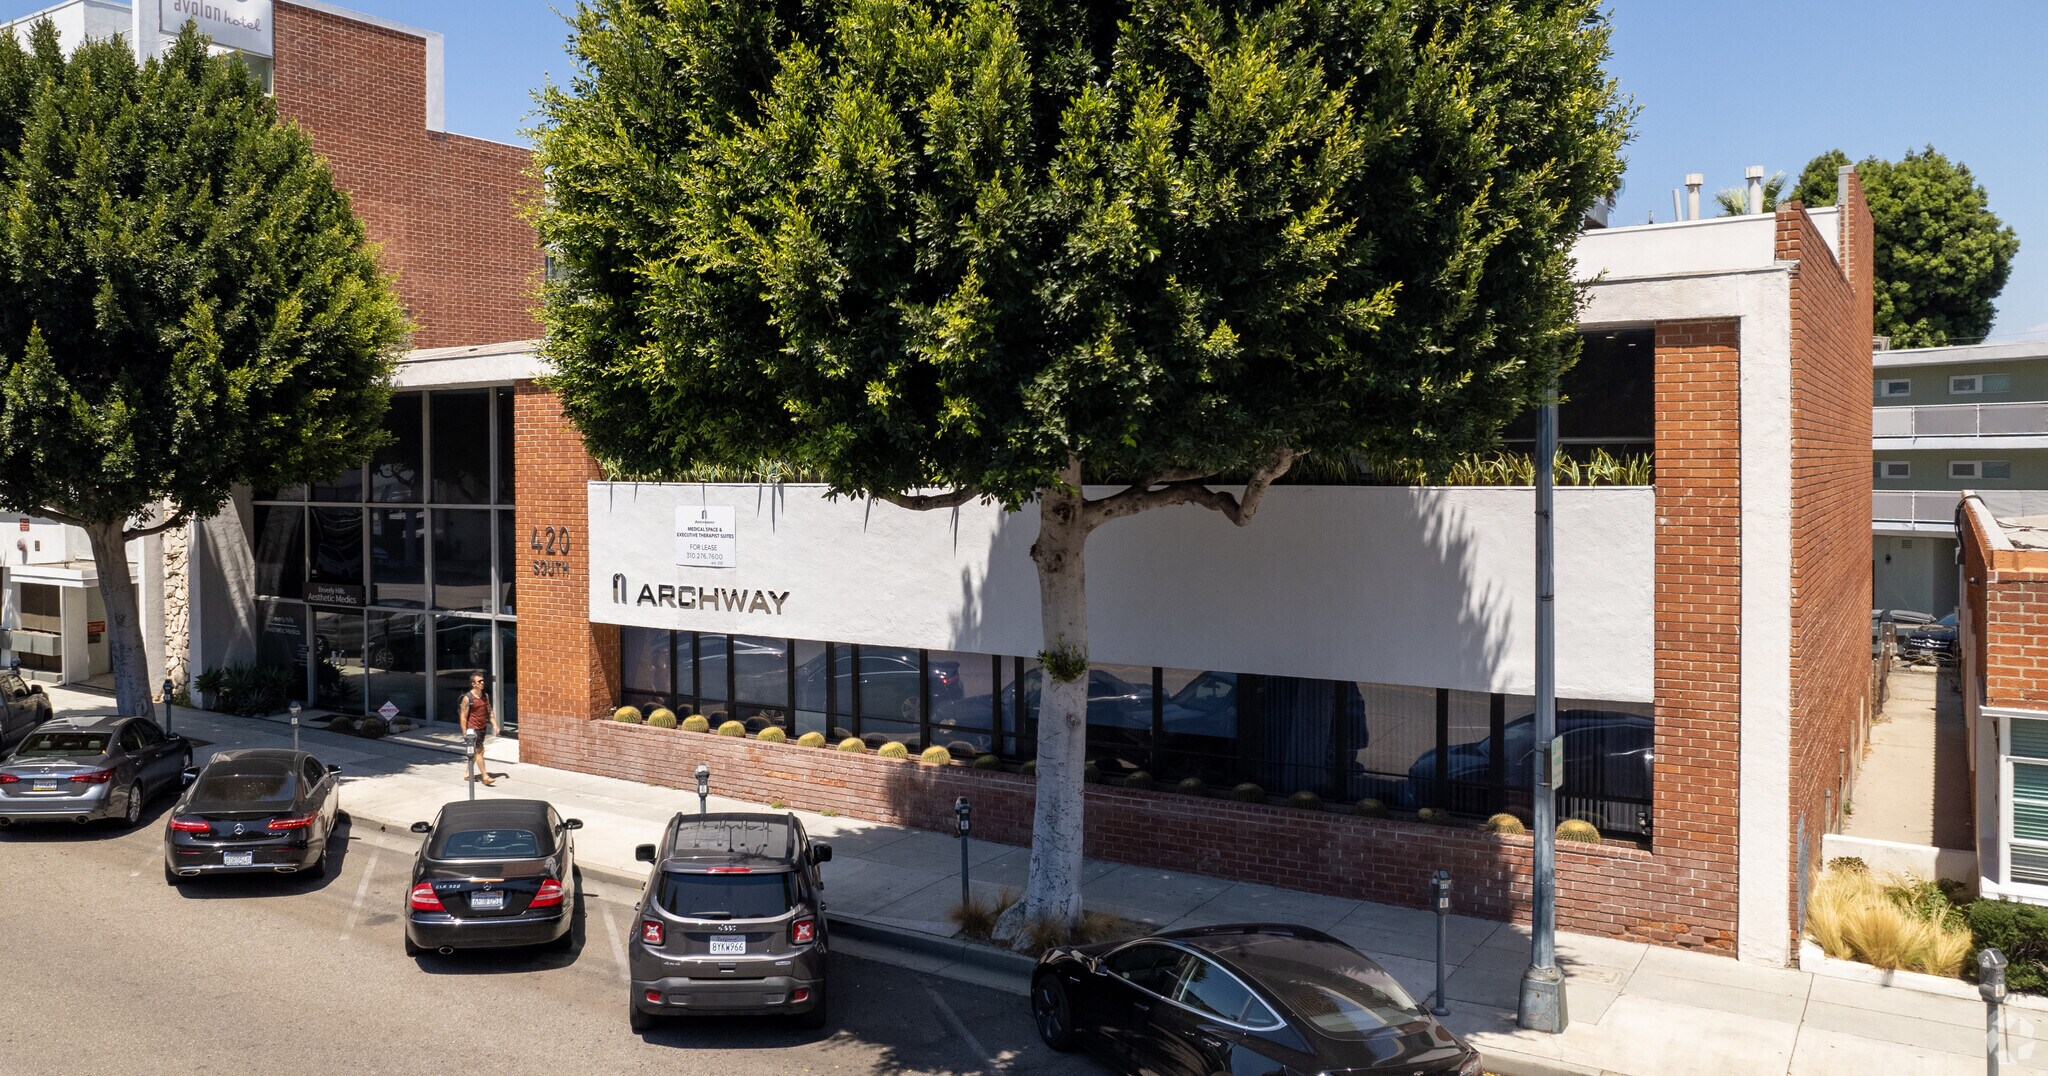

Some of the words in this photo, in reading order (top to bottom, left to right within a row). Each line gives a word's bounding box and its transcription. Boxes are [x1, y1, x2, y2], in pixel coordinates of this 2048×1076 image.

[224, 10, 262, 31] hotel
[531, 526, 570, 556] 420
[686, 552, 723, 560] 310.276.7600
[533, 560, 570, 578] SOUTH
[307, 592, 335, 602] Aesthetic
[336, 594, 357, 604] Medics
[318, 586, 335, 595] Beverly
[636, 583, 790, 615] ARCHWAY
[712, 942, 744, 952] 8YKW966
